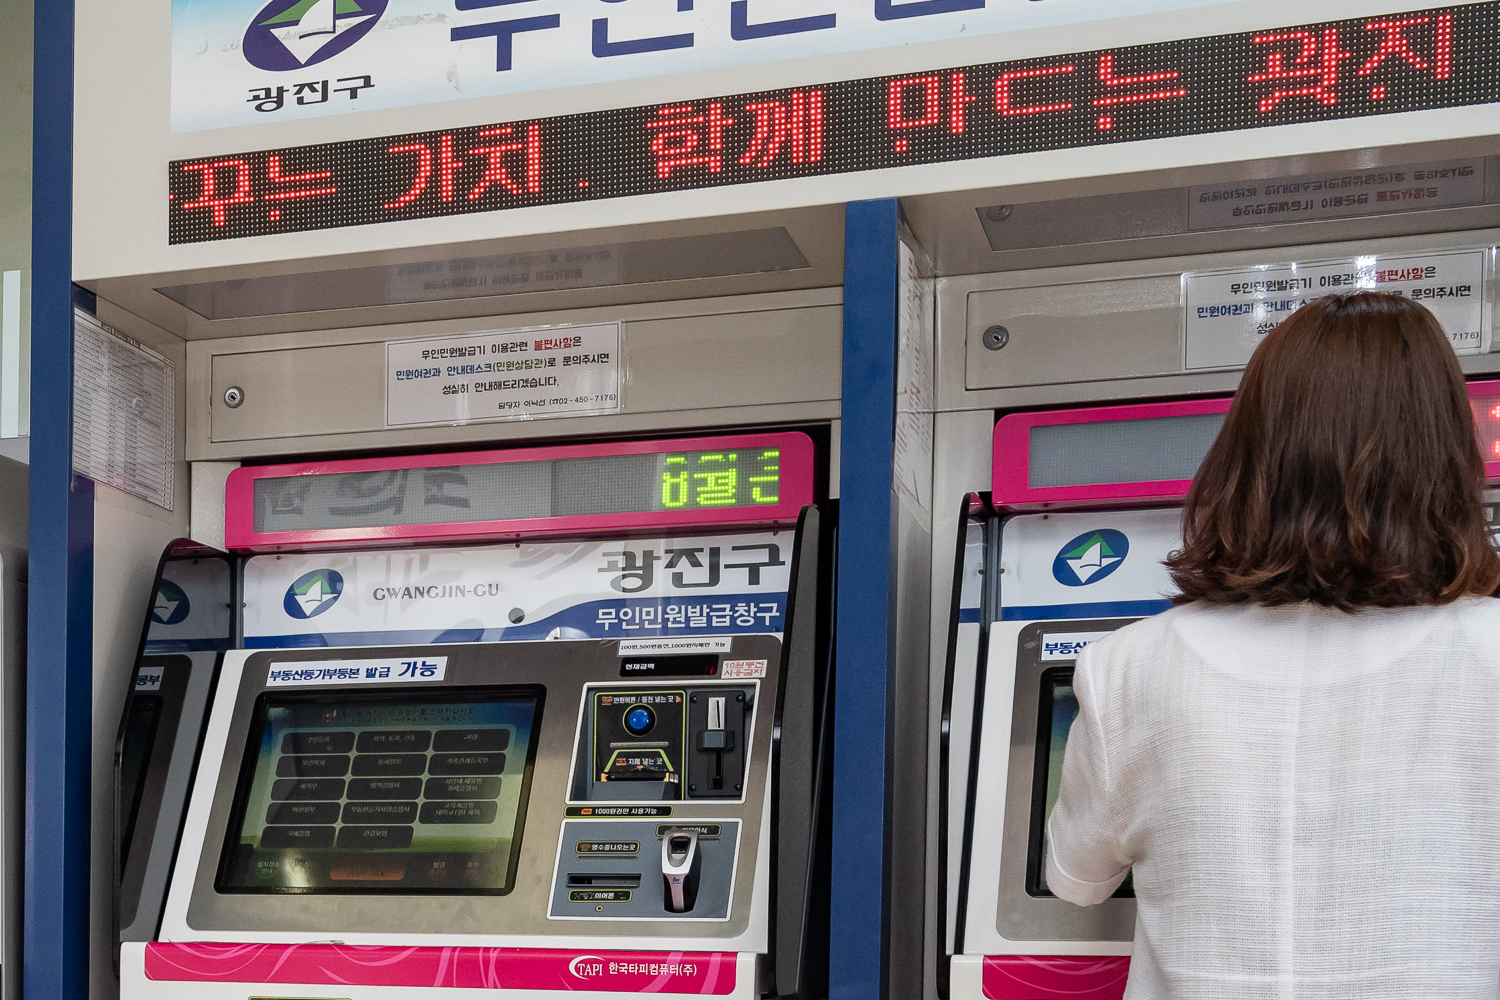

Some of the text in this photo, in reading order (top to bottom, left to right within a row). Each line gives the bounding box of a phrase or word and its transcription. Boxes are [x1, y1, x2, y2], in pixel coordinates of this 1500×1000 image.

[246, 75, 375, 112] 광진구
[1319, 272, 1368, 289] 이용관
[1411, 284, 1471, 300] 문의주시면
[422, 336, 582, 360] 무인민원발급기 이용관련 불편사항은
[396, 367, 441, 381] 민원여권과
[562, 353, 610, 366] 문의주시면
[442, 376, 560, 395] 성실히 안내해드리겠습니다.
[596, 543, 786, 593] 광진구
[373, 583, 499, 601] GWANGJIN-GU
[595, 602, 780, 632] 무인민원발급창구
[270, 660, 438, 682] 부동산등기부등본 발급 가능
[609, 961, 697, 978] 한국타피컴퓨터(주)
